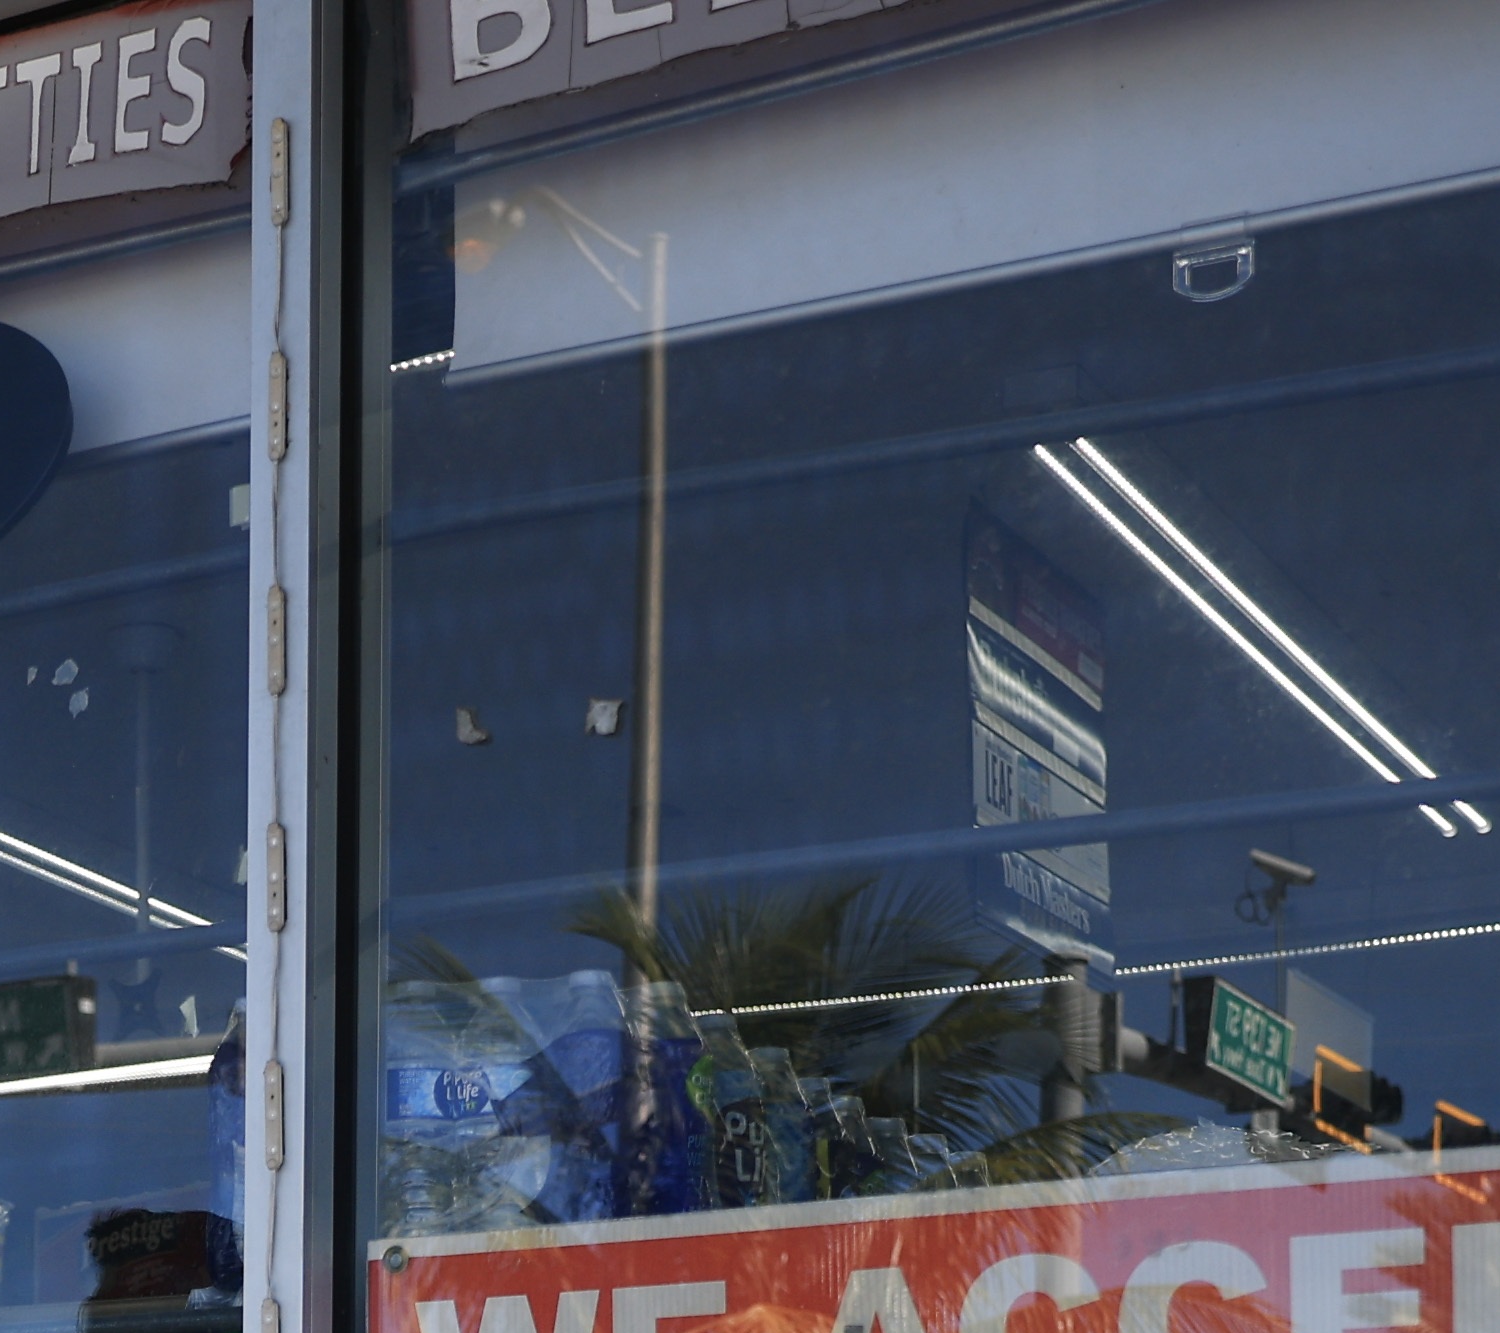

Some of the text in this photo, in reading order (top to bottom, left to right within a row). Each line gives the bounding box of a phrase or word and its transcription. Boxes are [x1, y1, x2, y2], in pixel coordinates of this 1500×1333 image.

[985, 750, 1013, 817] LEAF
[1002, 852, 1040, 905] Dutch
[457, 1083, 479, 1101] Life
